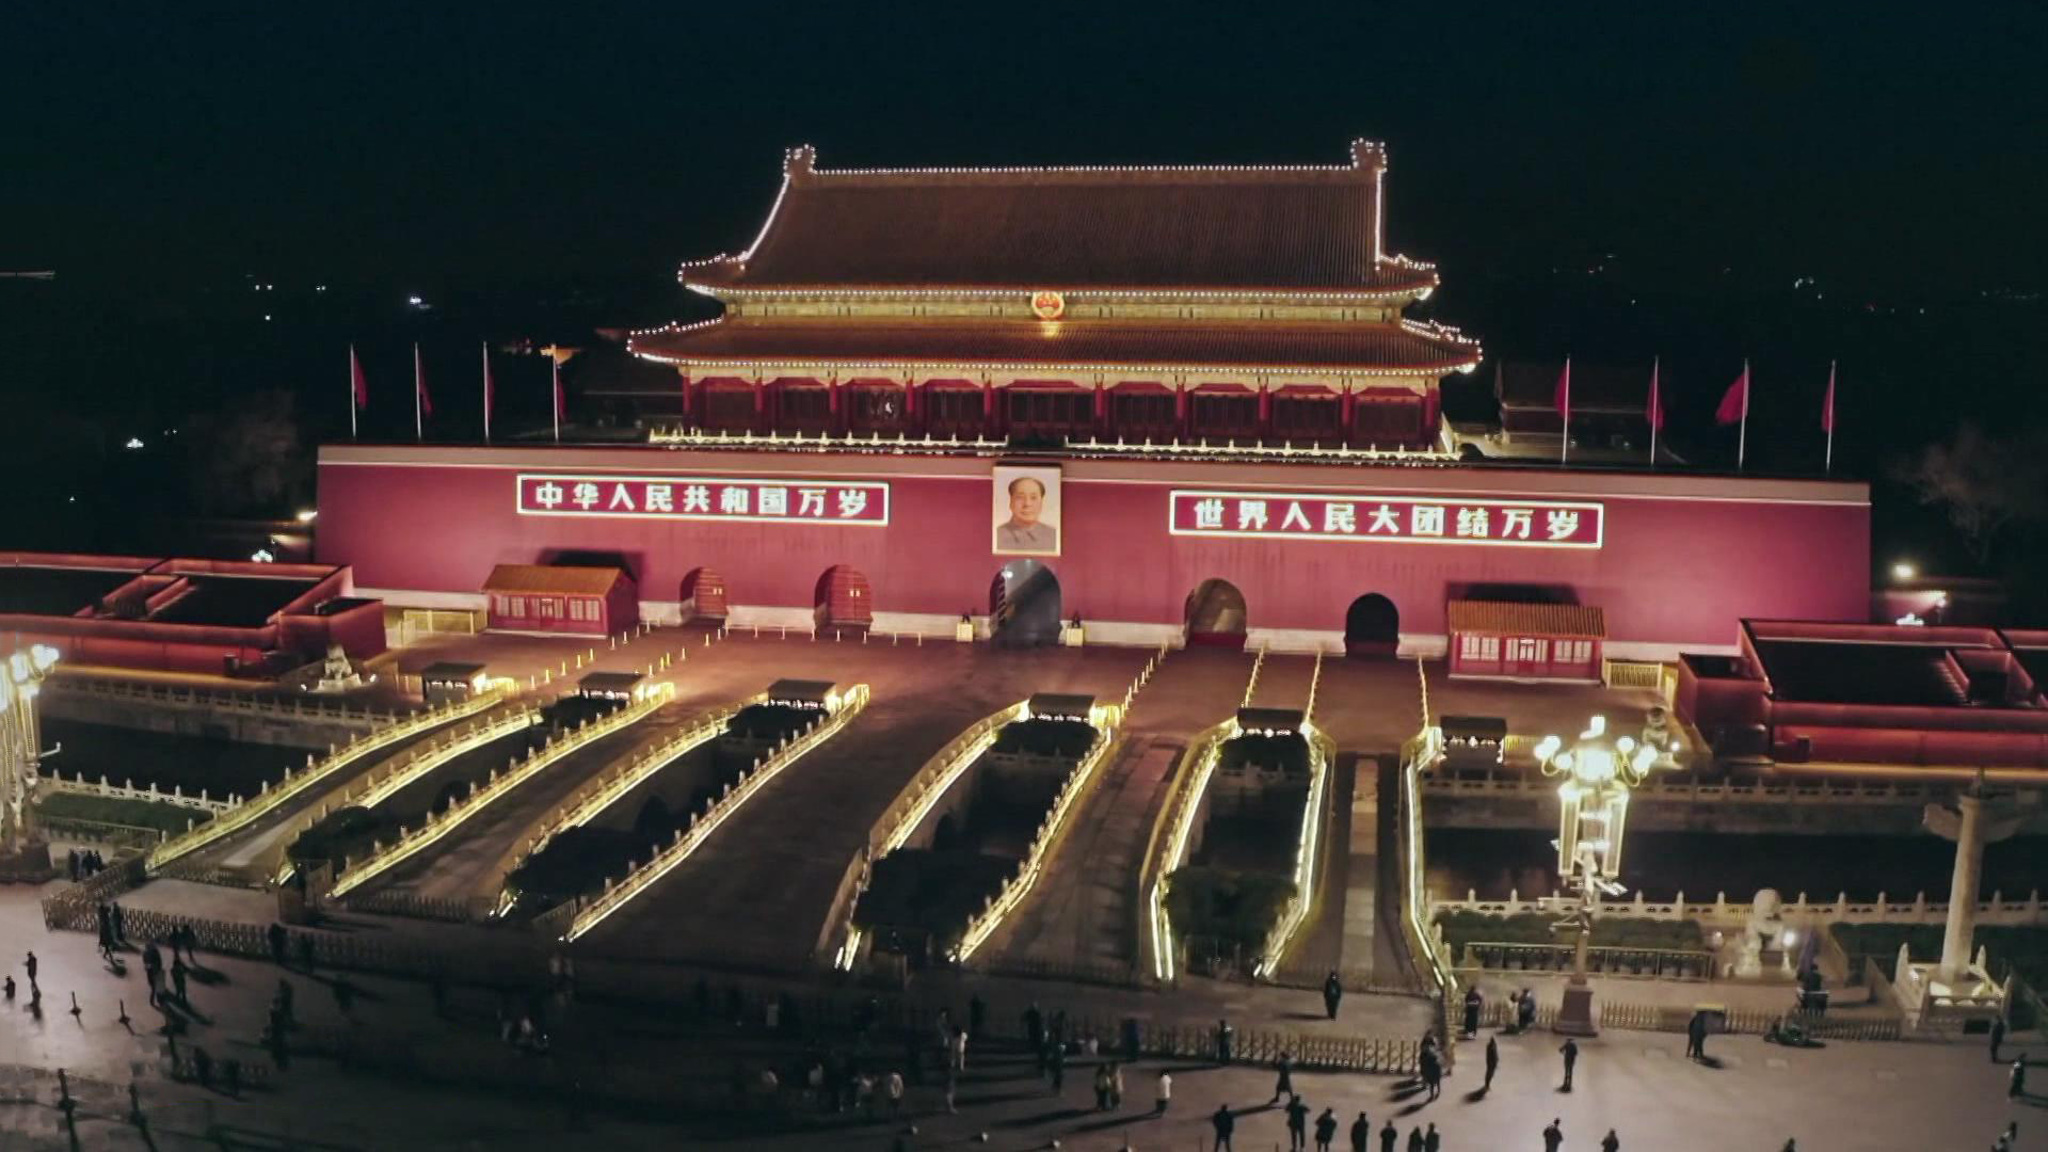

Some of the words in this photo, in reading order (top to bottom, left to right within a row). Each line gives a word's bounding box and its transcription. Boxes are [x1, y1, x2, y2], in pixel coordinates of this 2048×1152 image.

[535, 482, 867, 517] 中华人民共和国万岁
[1194, 498, 1580, 540] 世界人民大团结万岁
